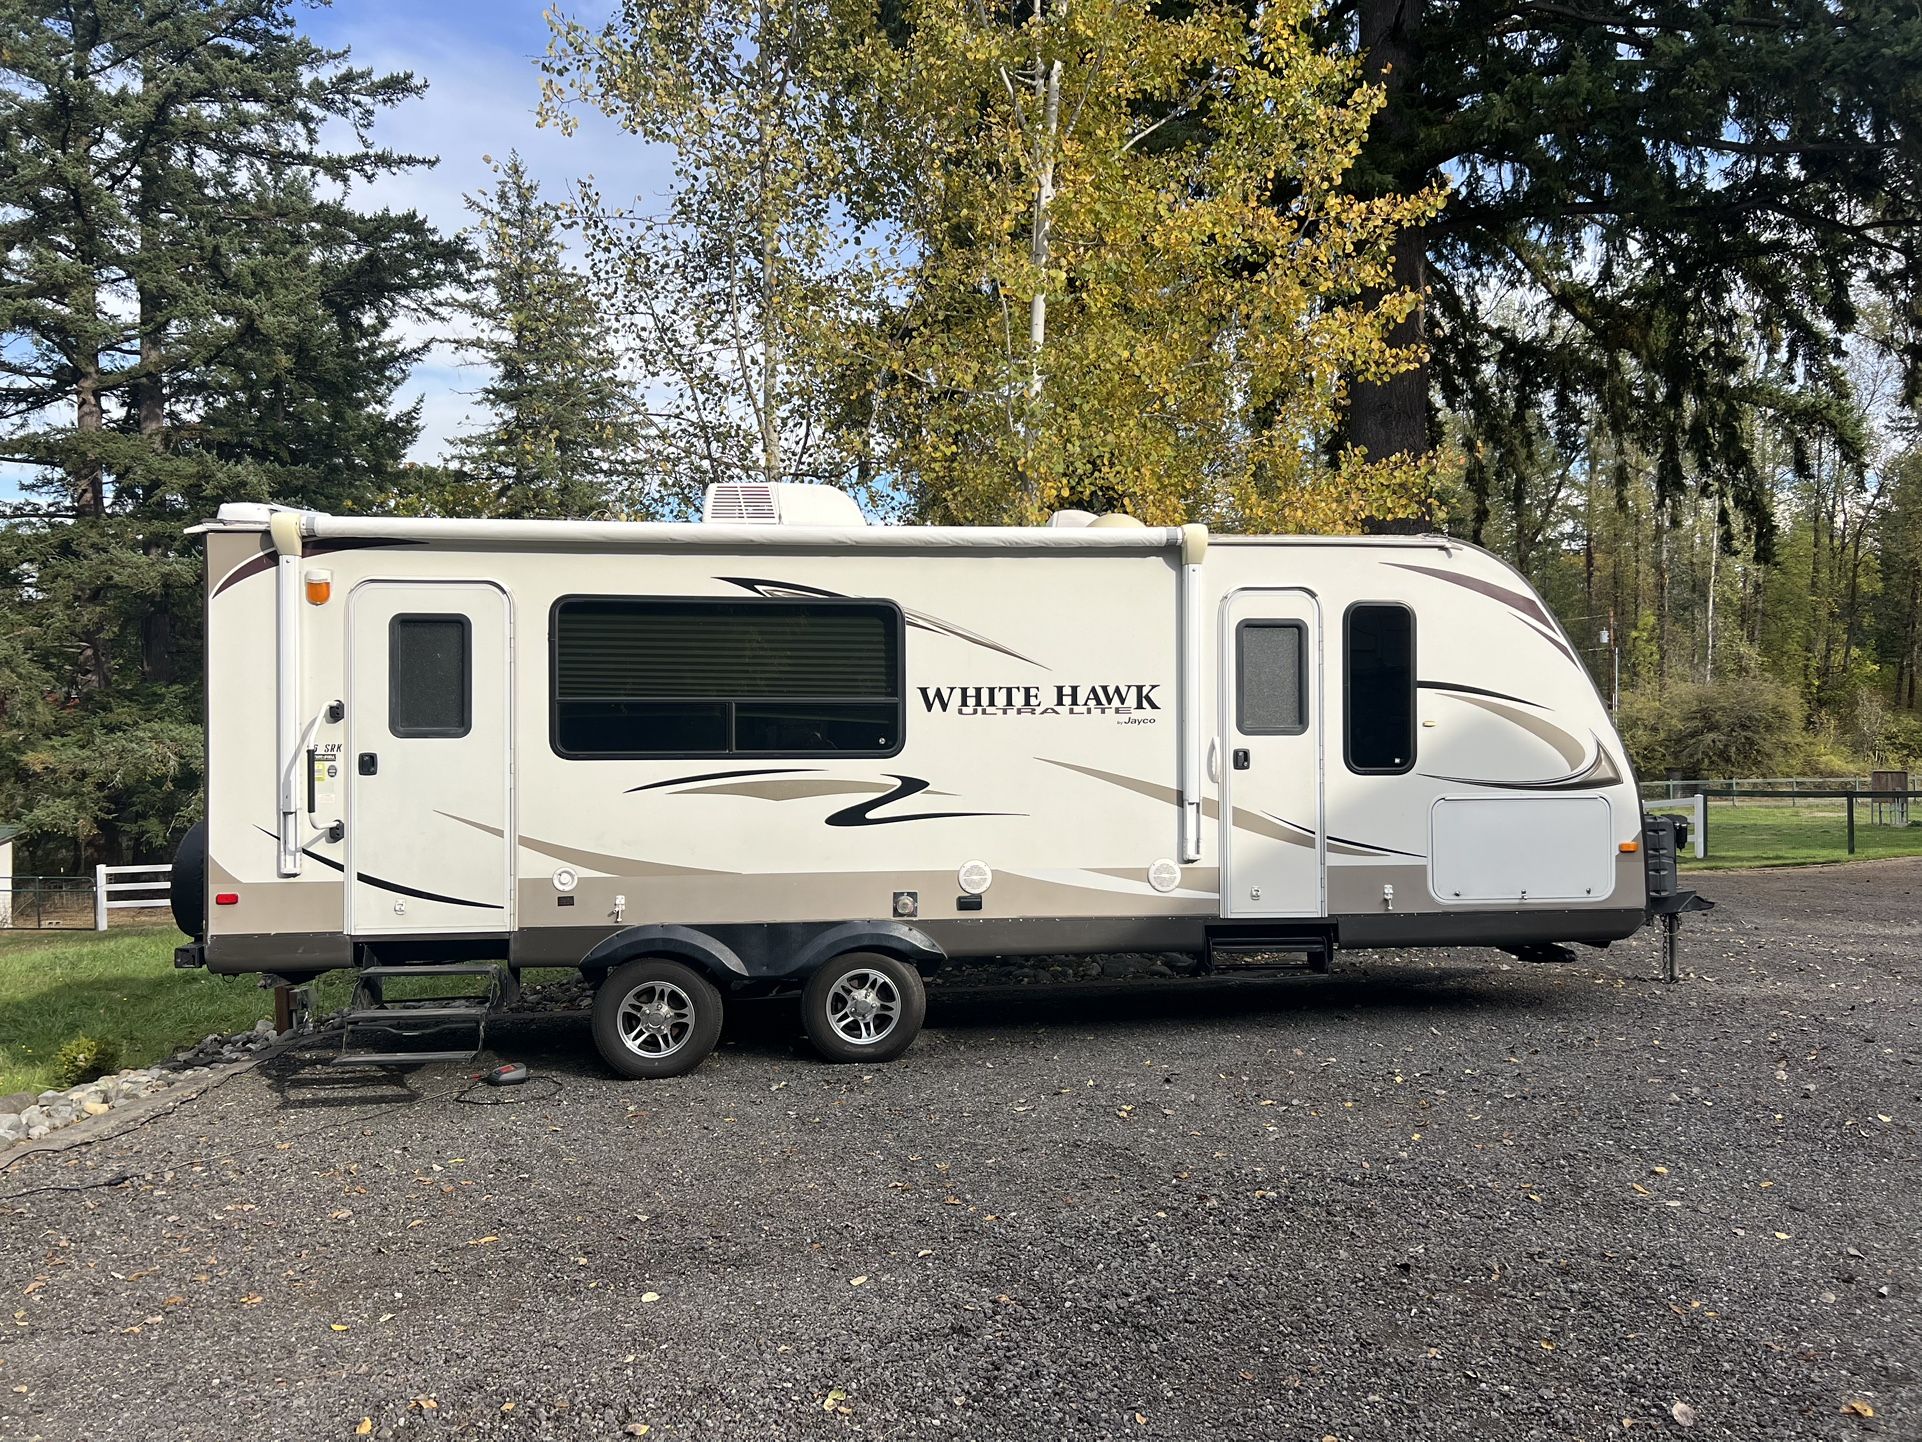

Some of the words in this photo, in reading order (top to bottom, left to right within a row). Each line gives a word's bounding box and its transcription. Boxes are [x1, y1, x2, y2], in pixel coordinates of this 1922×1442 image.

[916, 686, 1041, 712] WHITE
[1053, 684, 1161, 709] HAWK
[957, 707, 1060, 715] ULTRA
[1069, 706, 1132, 714] LITE
[1124, 716, 1156, 725] Jayco
[324, 743, 343, 753] SRK
